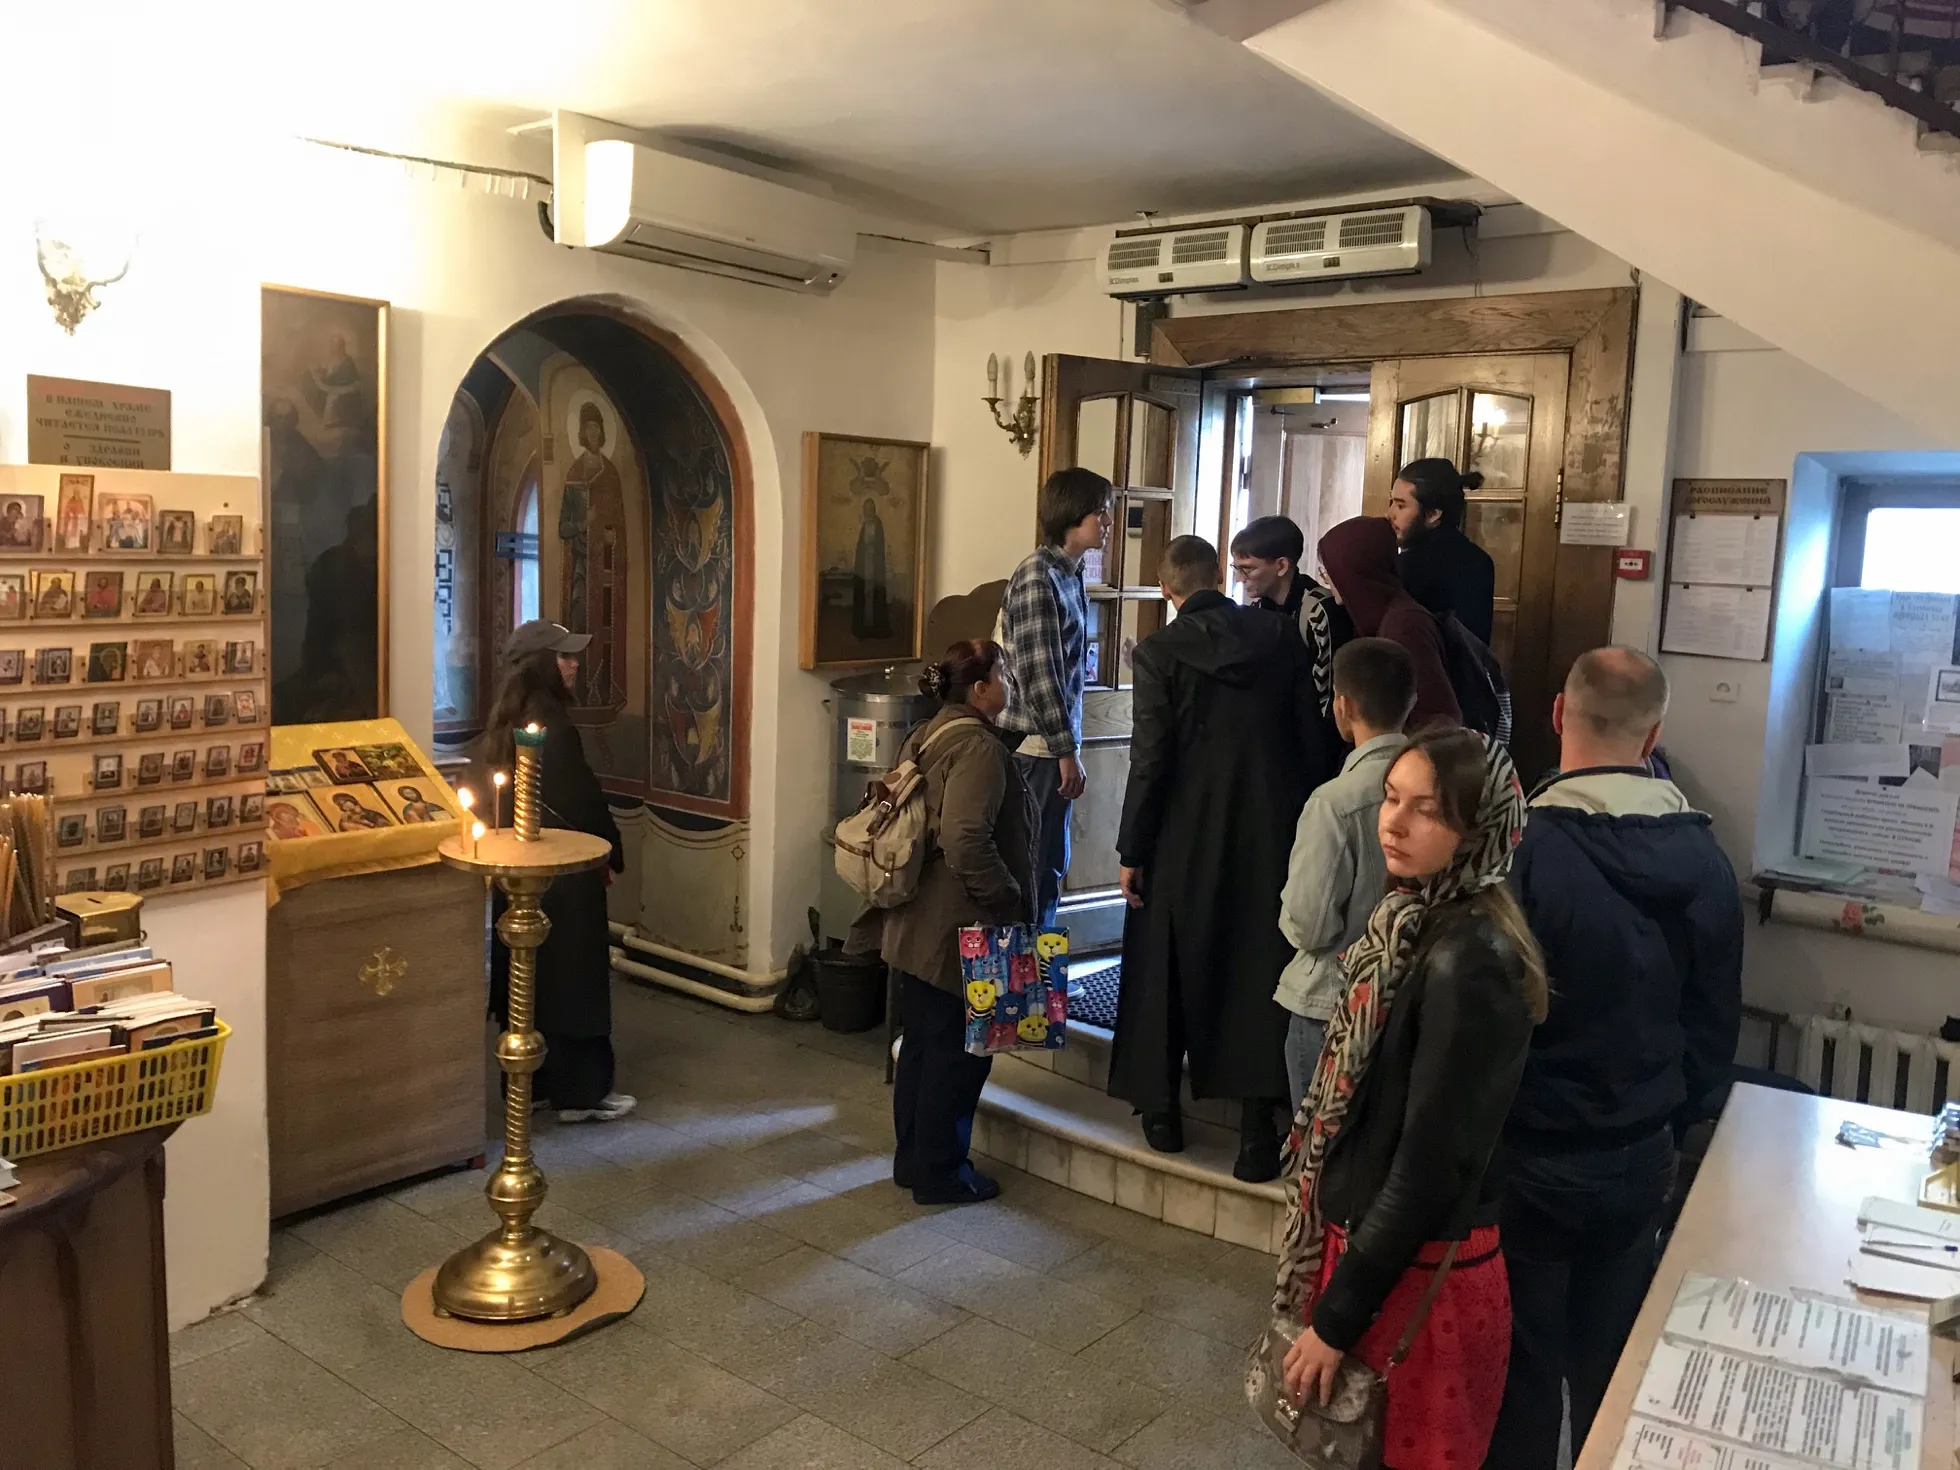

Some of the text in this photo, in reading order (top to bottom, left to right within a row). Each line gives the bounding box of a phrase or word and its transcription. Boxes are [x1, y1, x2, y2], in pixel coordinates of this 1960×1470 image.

[56, 395, 104, 408] НАШЕМ
[112, 401, 152, 413] ХРАМЕ
[65, 409, 137, 423] ЕЖЕДНЕВНО
[36, 417, 100, 431] ЧИТАЕТСЯ
[1690, 486, 1768, 494] РАСПИСАНИЕ
[1685, 496, 1771, 506] БОГОСЛУЖЕНИЙ
